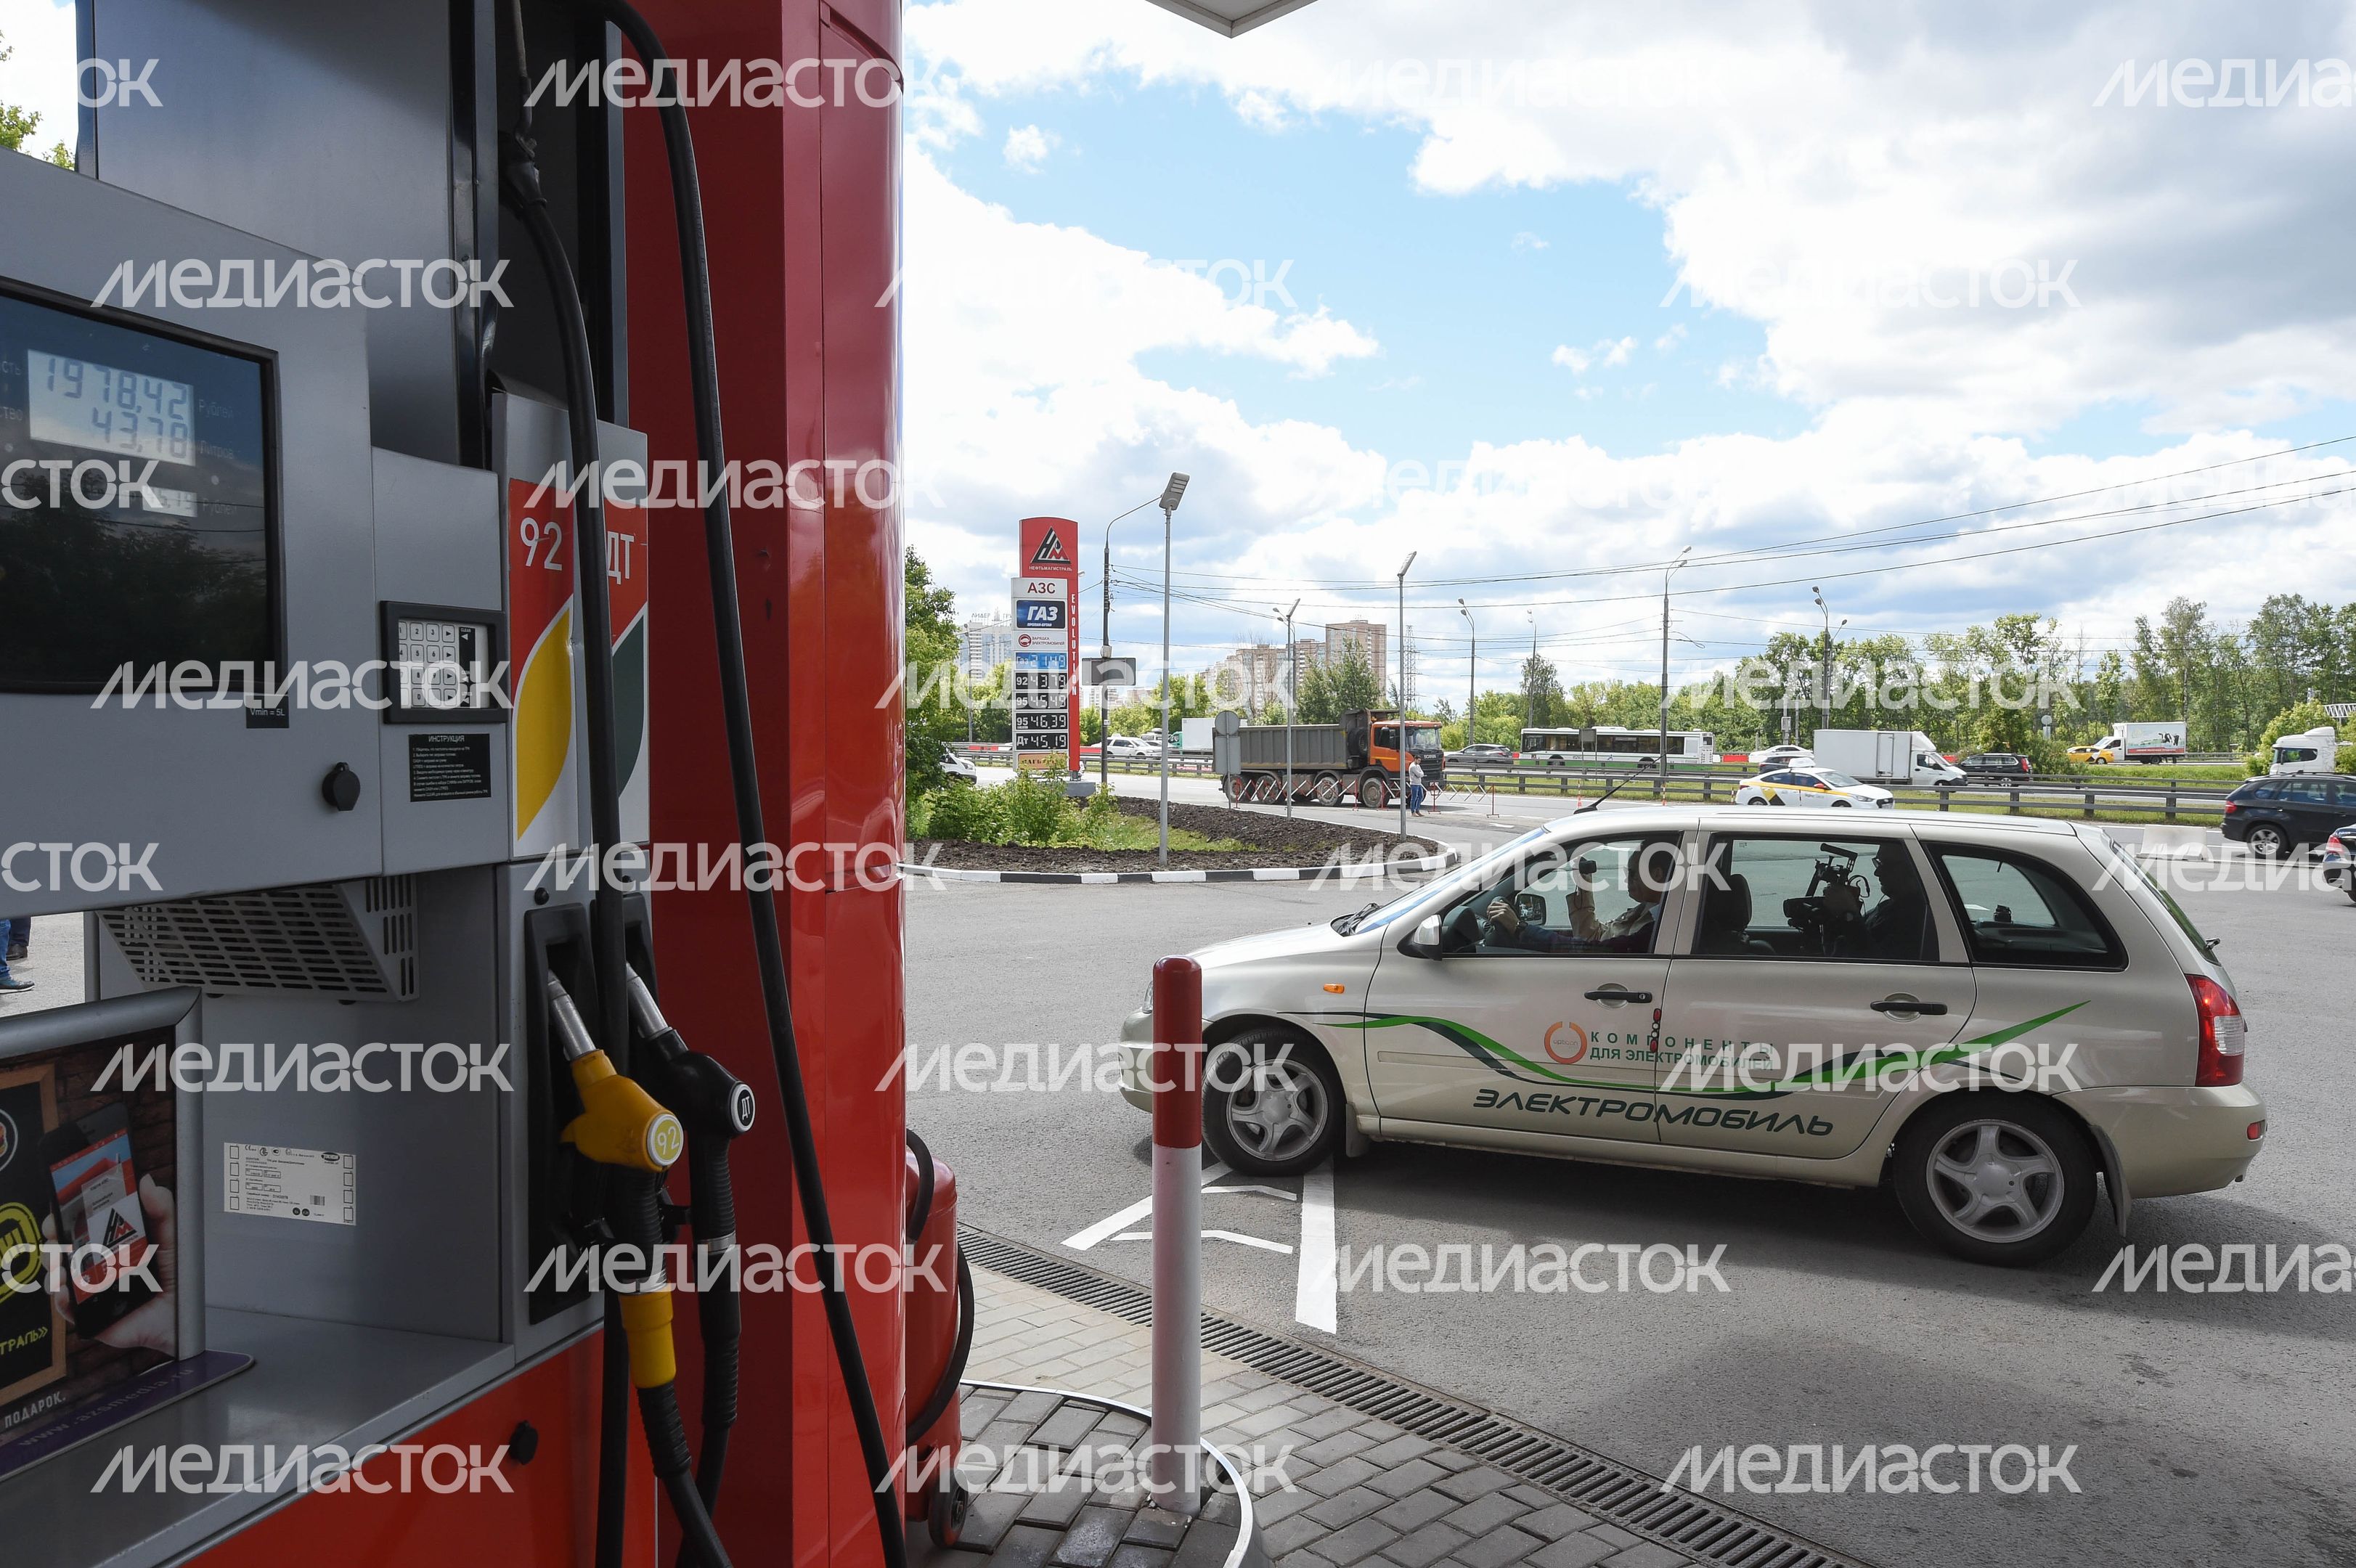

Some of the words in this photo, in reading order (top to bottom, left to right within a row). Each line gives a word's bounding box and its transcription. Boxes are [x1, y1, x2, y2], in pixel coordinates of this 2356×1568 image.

[520, 516, 563, 571] 92
[606, 531, 635, 585] ДТ
[1027, 582, 1056, 594] АЗС
[1027, 606, 1059, 621] ГАЗ
[1016, 677, 1028, 686] 92
[1016, 697, 1028, 706] 95
[1016, 717, 1029, 726] 95
[1030, 714, 1067, 729] 46.39
[428, 735, 465, 743] ИНСТРУКЦИЯ
[1590, 1047, 1621, 1060] ДЛЯ
[741, 1095, 751, 1121] ДТ
[1472, 1089, 1834, 1136] ЭЛЕКТРОМОБИЛЬ
[656, 1126, 680, 1156] 92
